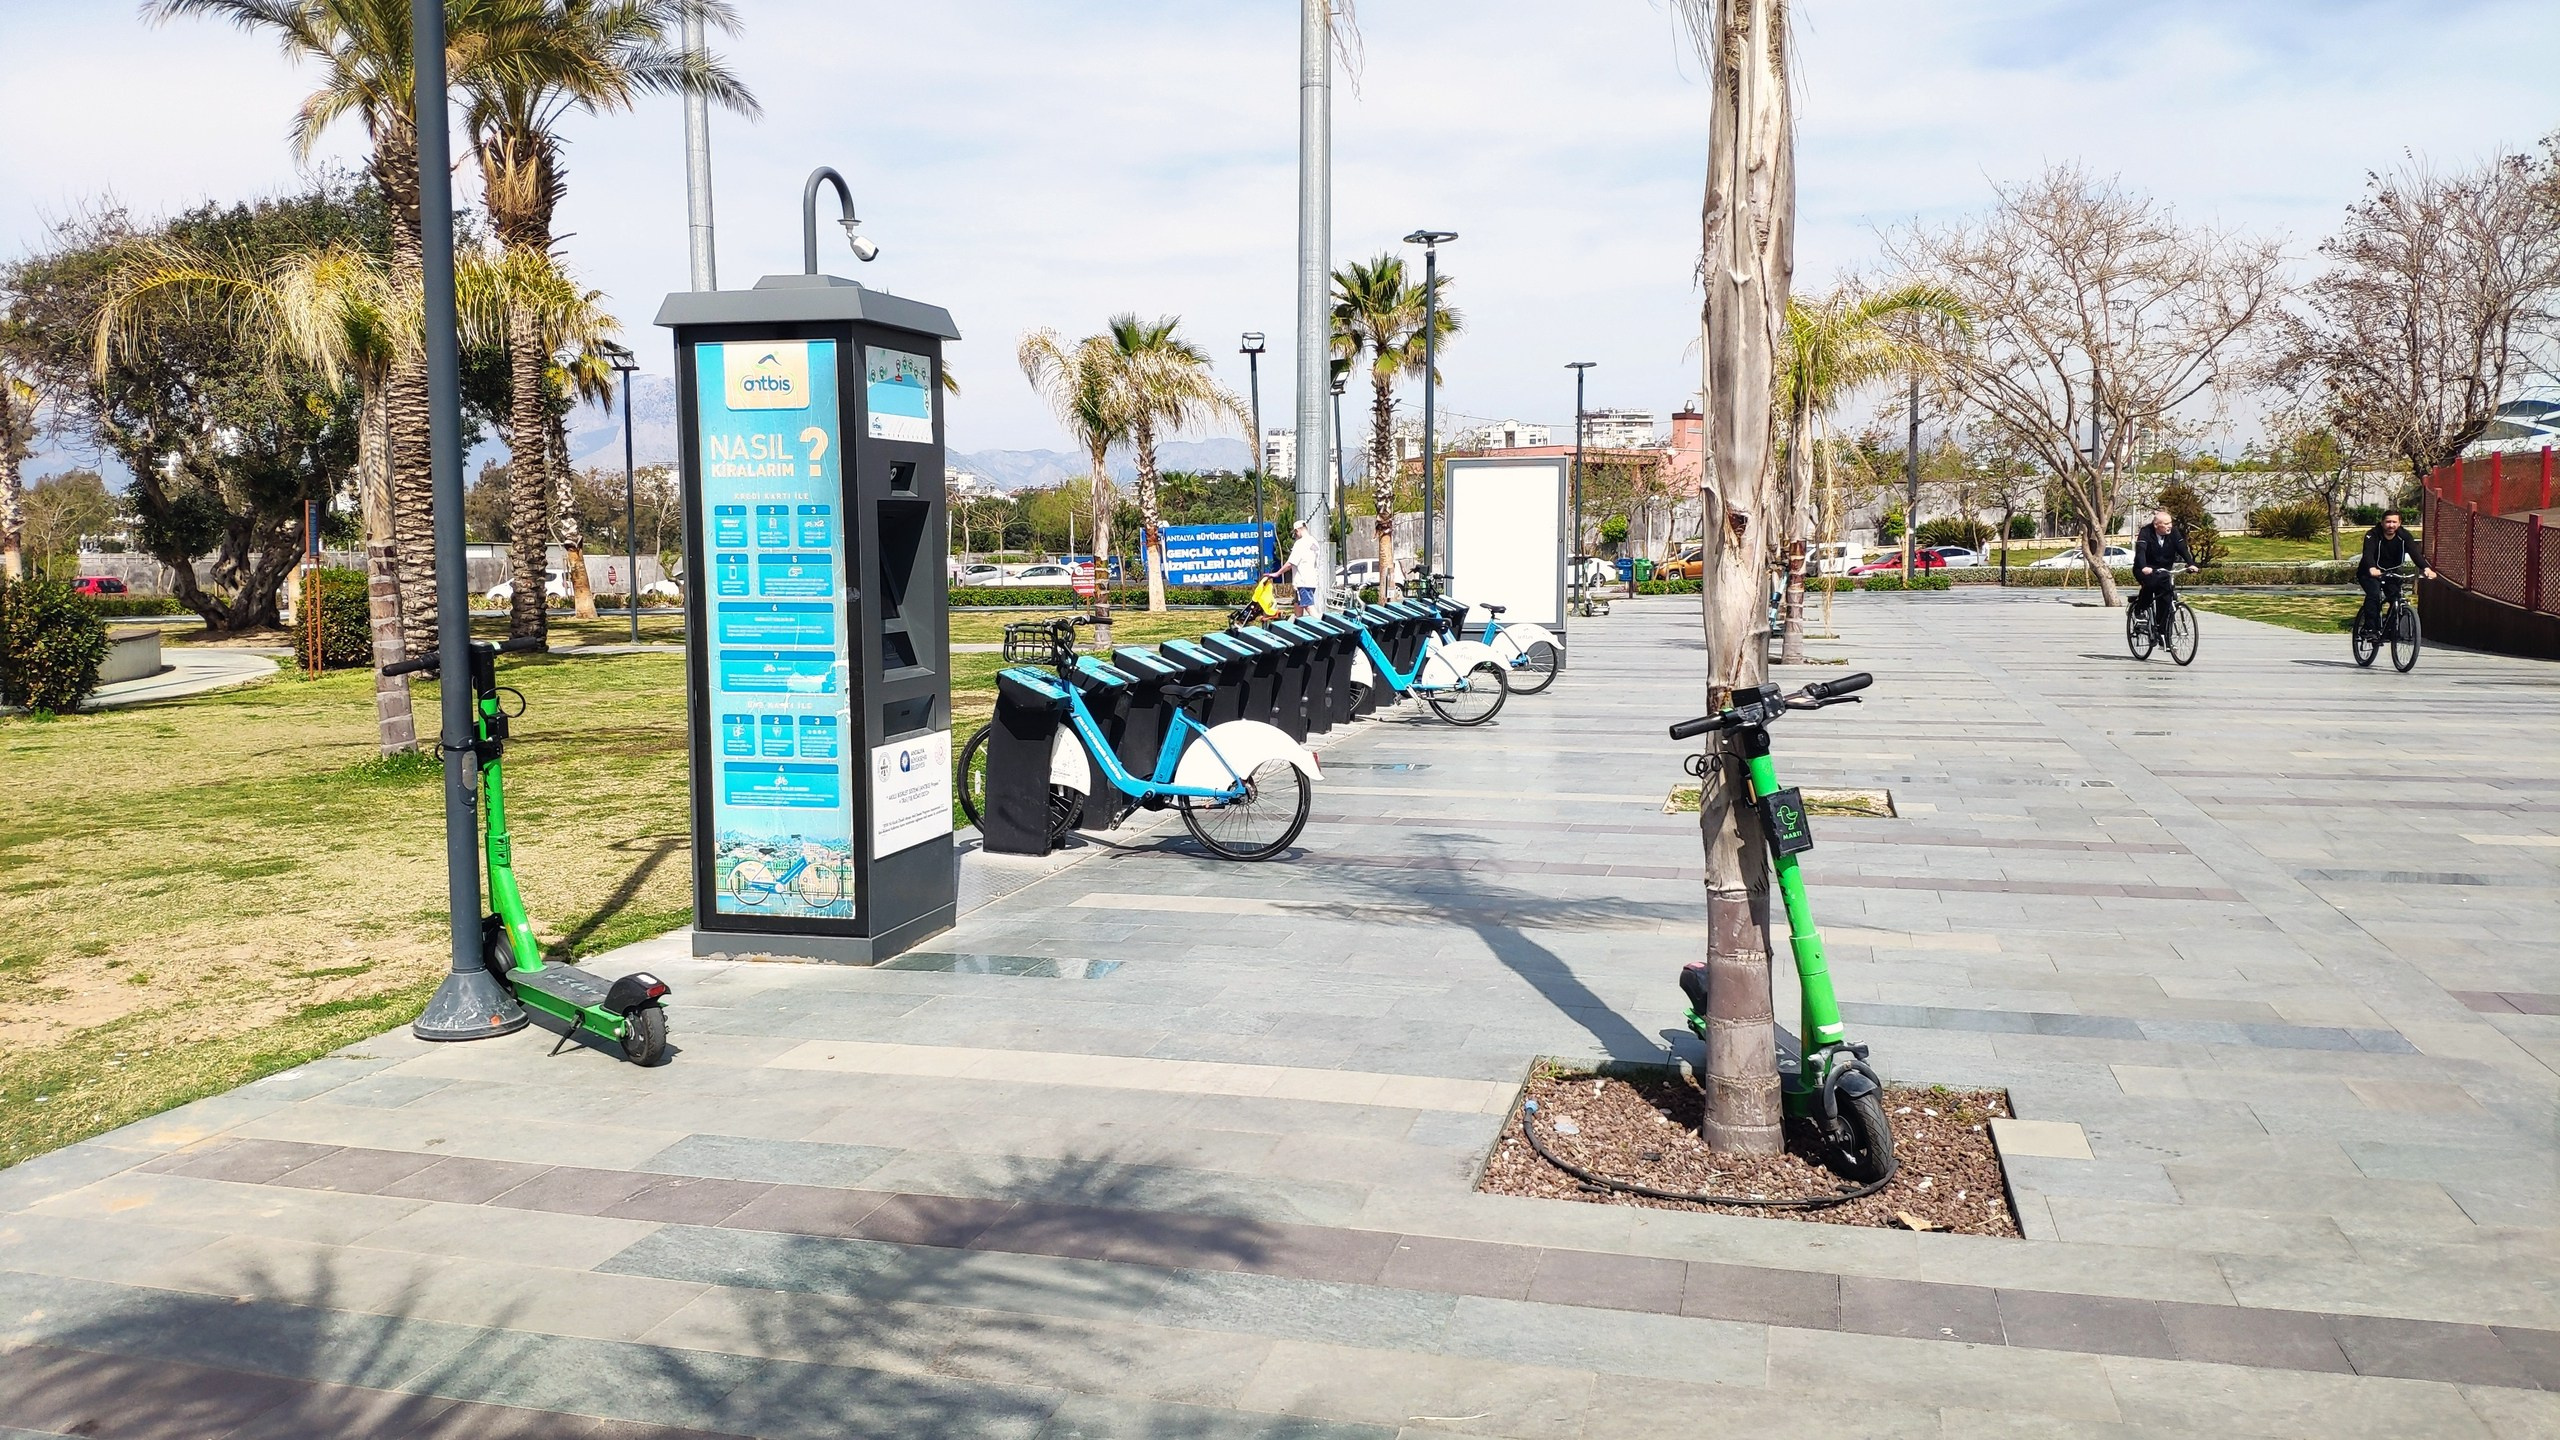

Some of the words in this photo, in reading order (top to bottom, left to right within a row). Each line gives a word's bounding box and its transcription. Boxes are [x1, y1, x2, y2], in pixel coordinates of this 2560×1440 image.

[744, 375, 791, 391] antbis
[710, 433, 794, 461] NASIL
[711, 460, 795, 478] KİRALARIM
[1166, 534, 1195, 542] ANTALYA
[1196, 531, 1239, 541] BÜYÜKŞEHİR
[1240, 530, 1273, 539] BELEDESİ
[1166, 545, 1214, 559] GENÇLİK
[1215, 548, 1229, 557] ve
[1230, 545, 1260, 556] SPOR
[1182, 569, 1249, 584] BAŞKANLIĞI
[1782, 830, 1803, 840] MARTI
